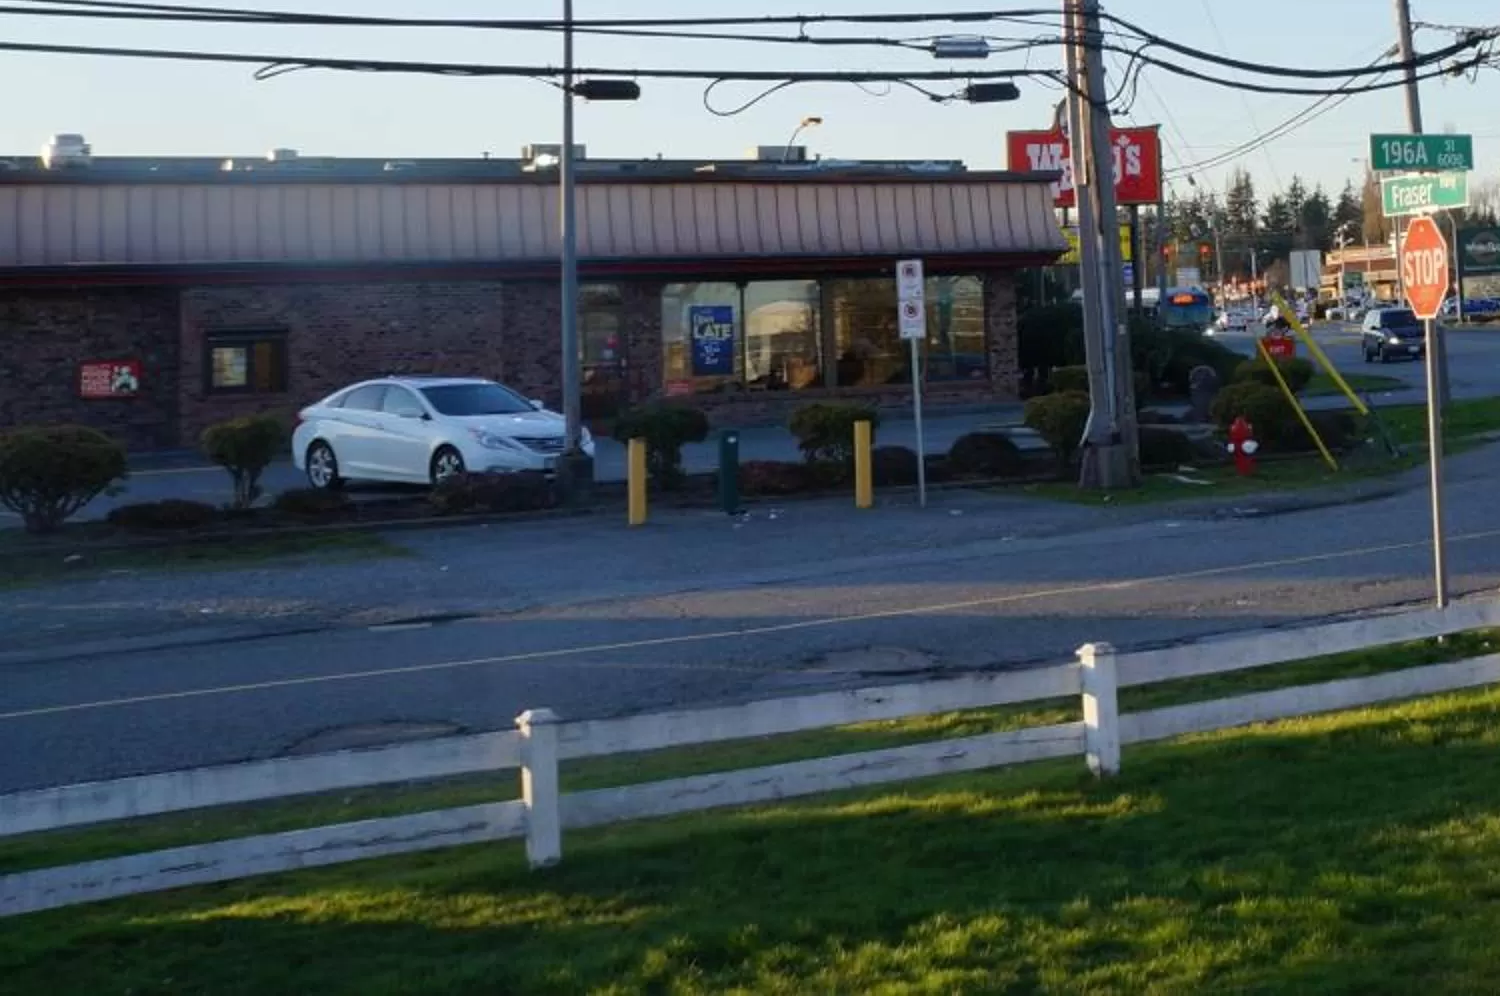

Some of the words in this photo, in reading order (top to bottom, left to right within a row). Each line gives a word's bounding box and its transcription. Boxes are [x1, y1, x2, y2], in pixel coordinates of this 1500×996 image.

[1381, 140, 1428, 164] 196A
[1391, 183, 1432, 208] Fraser
[1404, 247, 1444, 289] STOP
